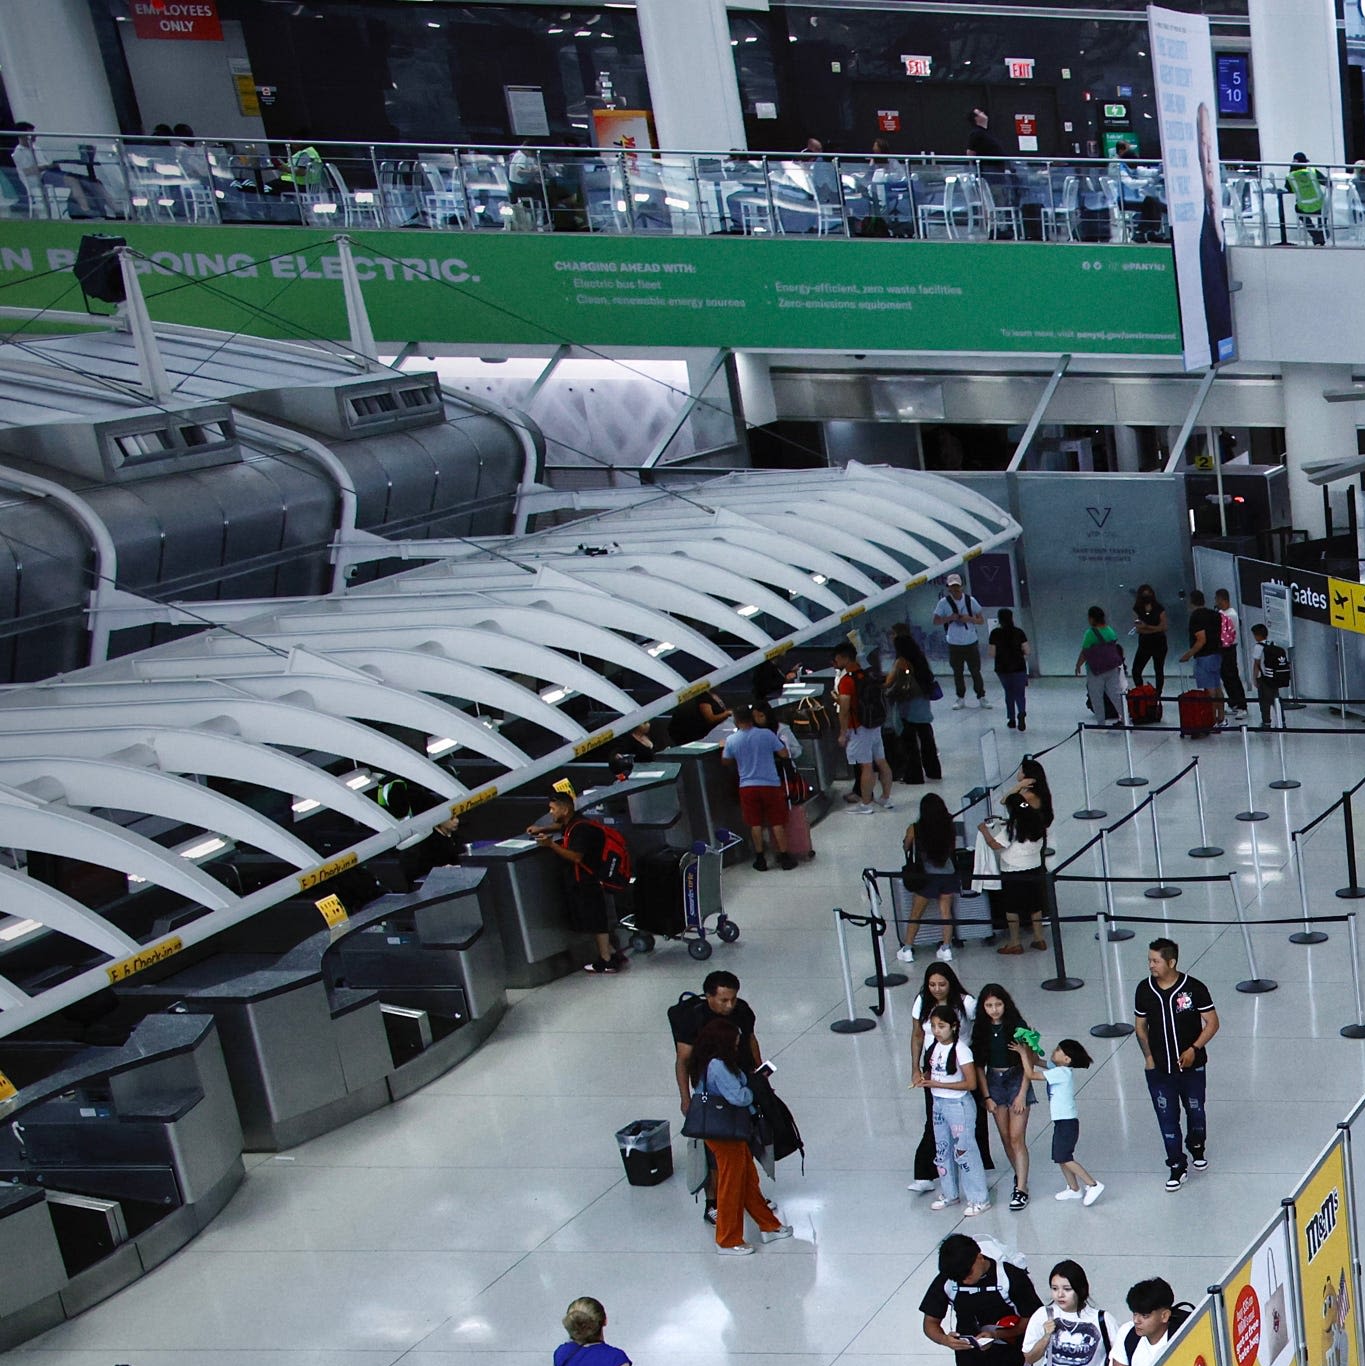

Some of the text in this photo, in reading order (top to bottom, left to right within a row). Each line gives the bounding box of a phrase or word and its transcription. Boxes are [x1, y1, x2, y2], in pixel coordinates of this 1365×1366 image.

[160, 20, 195, 32] ONLY
[1013, 63, 1030, 78] EXIT
[1233, 72, 1241, 84] 5
[1226, 89, 1242, 102] 10
[272, 255, 481, 282] ELECTRIC.
[554, 261, 696, 274] CHARGING AHEAD WITH:
[1200, 457, 1208, 467] 2
[1290, 585, 1327, 610] Gates
